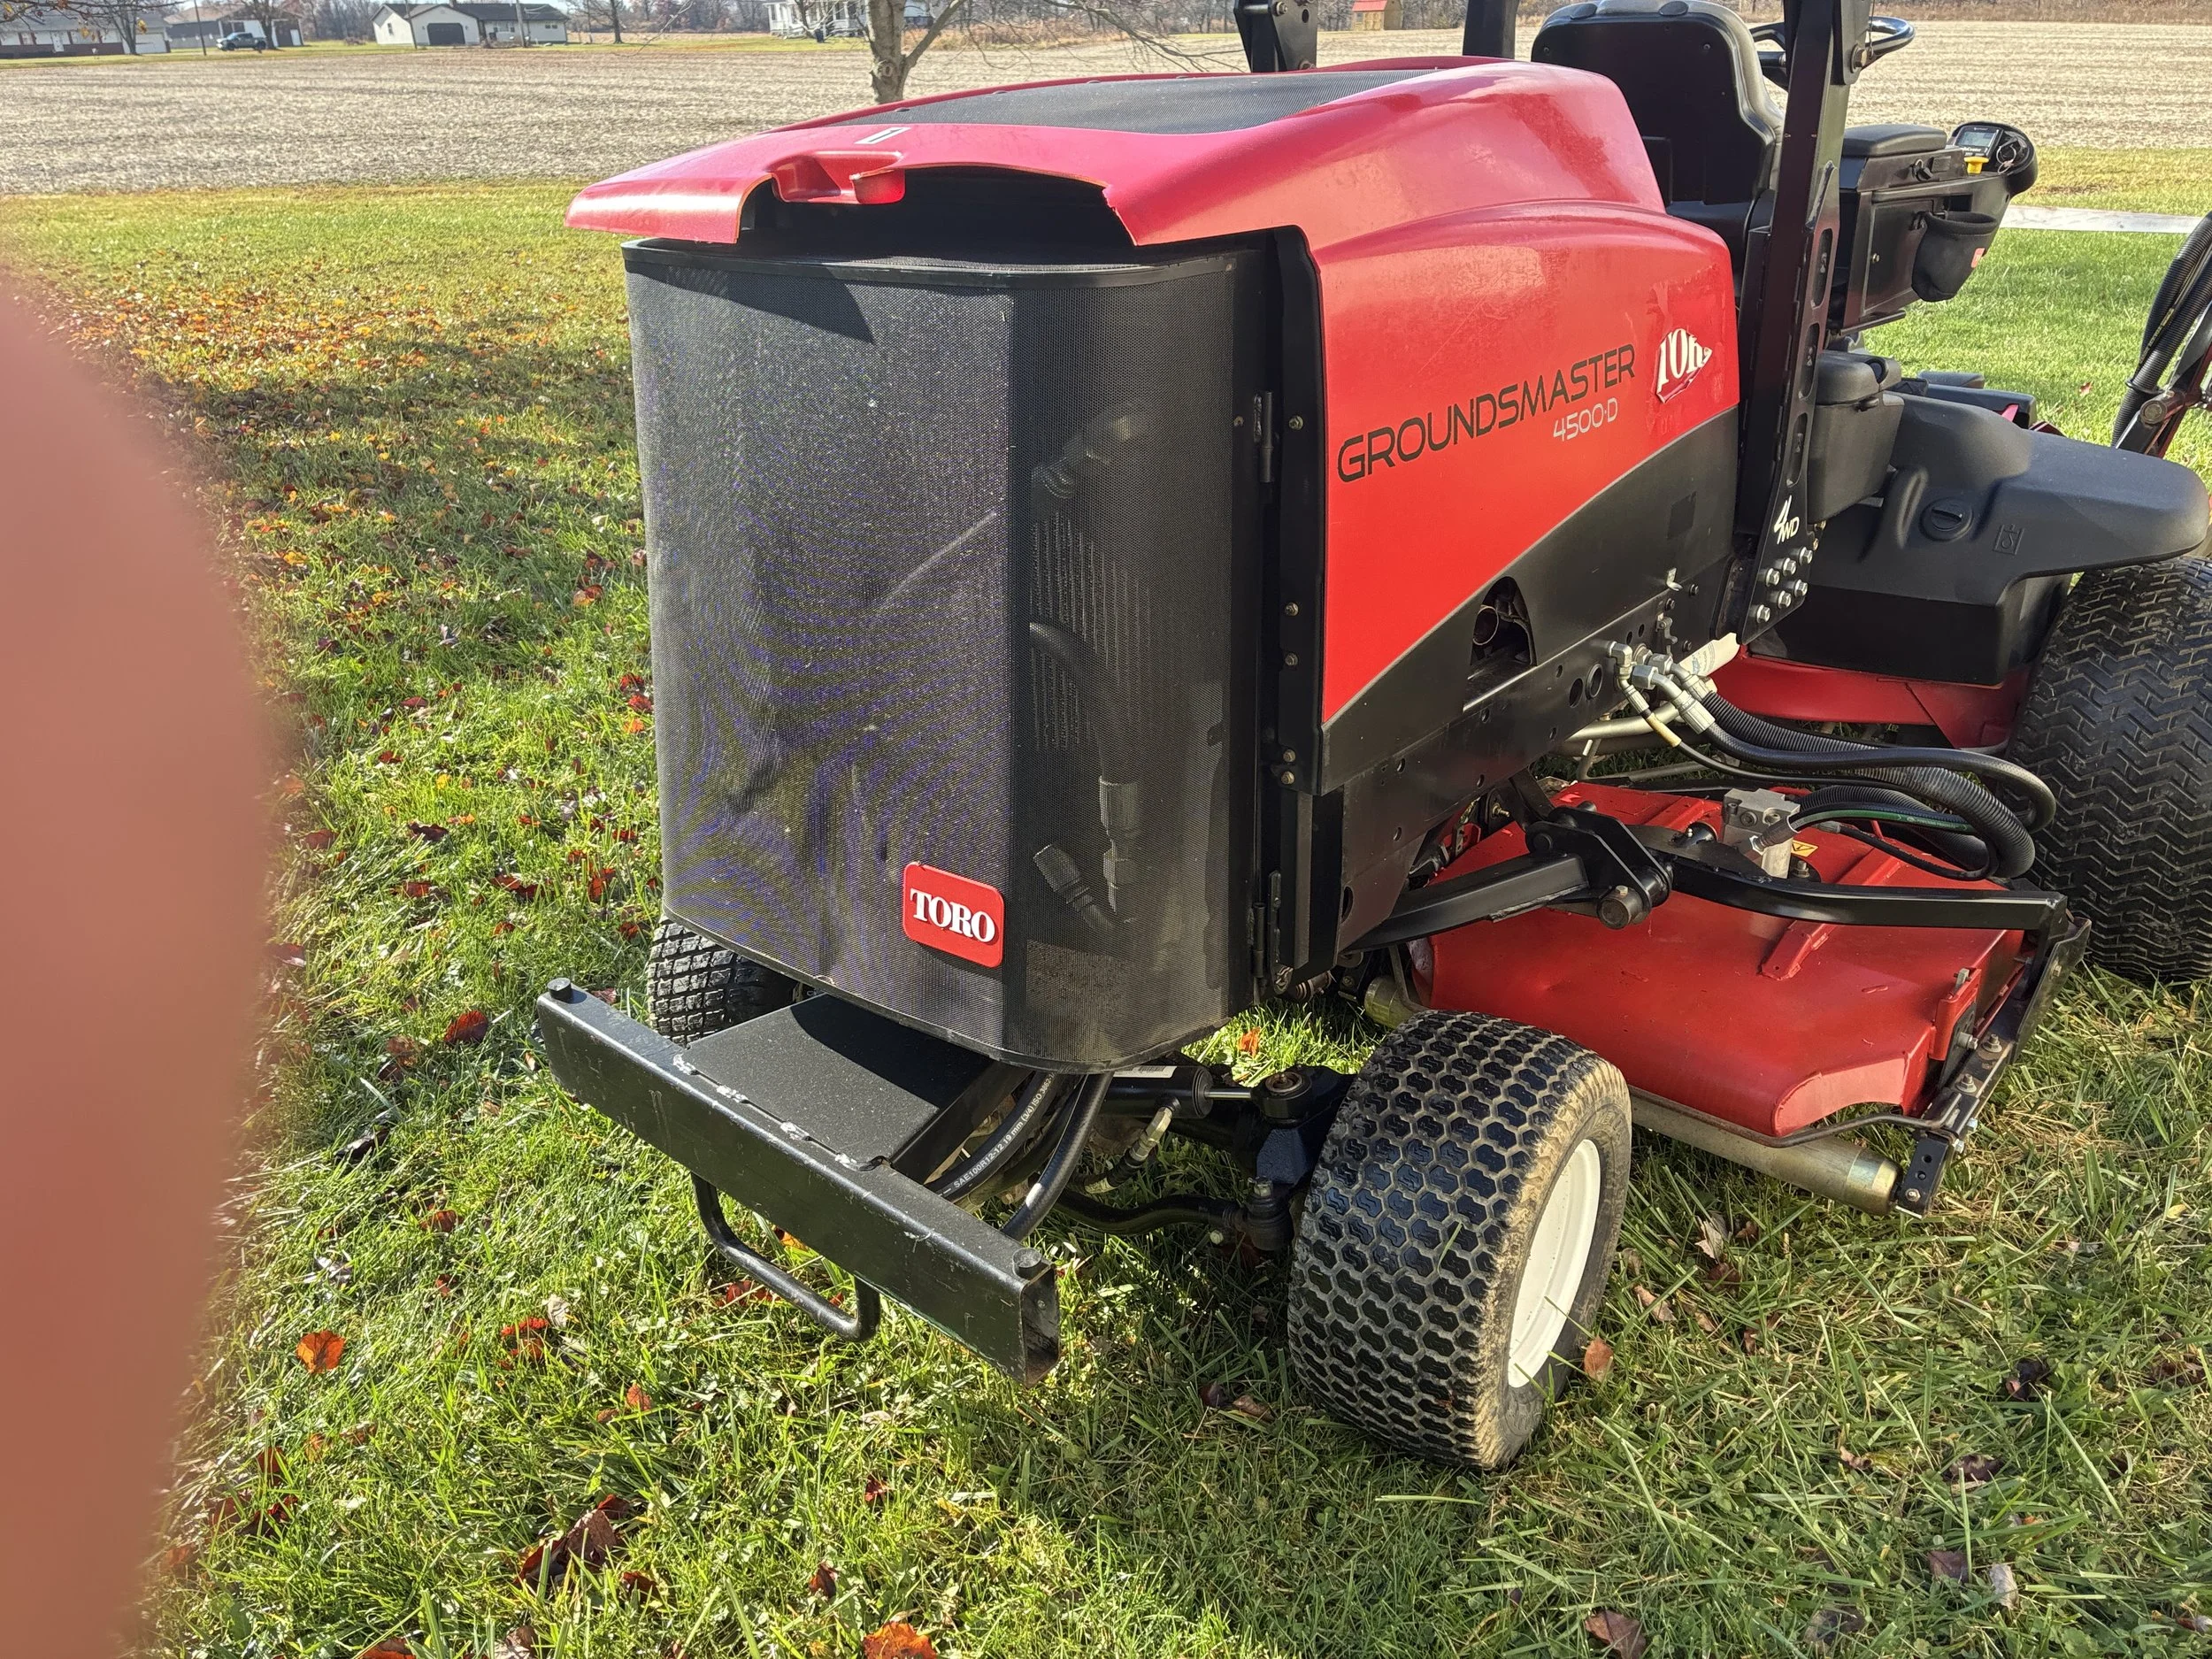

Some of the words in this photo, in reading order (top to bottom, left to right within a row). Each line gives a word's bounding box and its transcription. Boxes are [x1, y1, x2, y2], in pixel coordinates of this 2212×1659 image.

[1338, 344, 1635, 482] GROUNDSMASTER
[1774, 495, 1800, 544] 4WD
[910, 888, 995, 942] TORO
[954, 1143, 1004, 1187] SAE100R12-12
[1003, 1134, 1013, 1145] 19
[1011, 1121, 1024, 1136] mm
[1020, 1106, 1034, 1122] (3/4)
[1032, 1094, 1042, 1107] ISO
